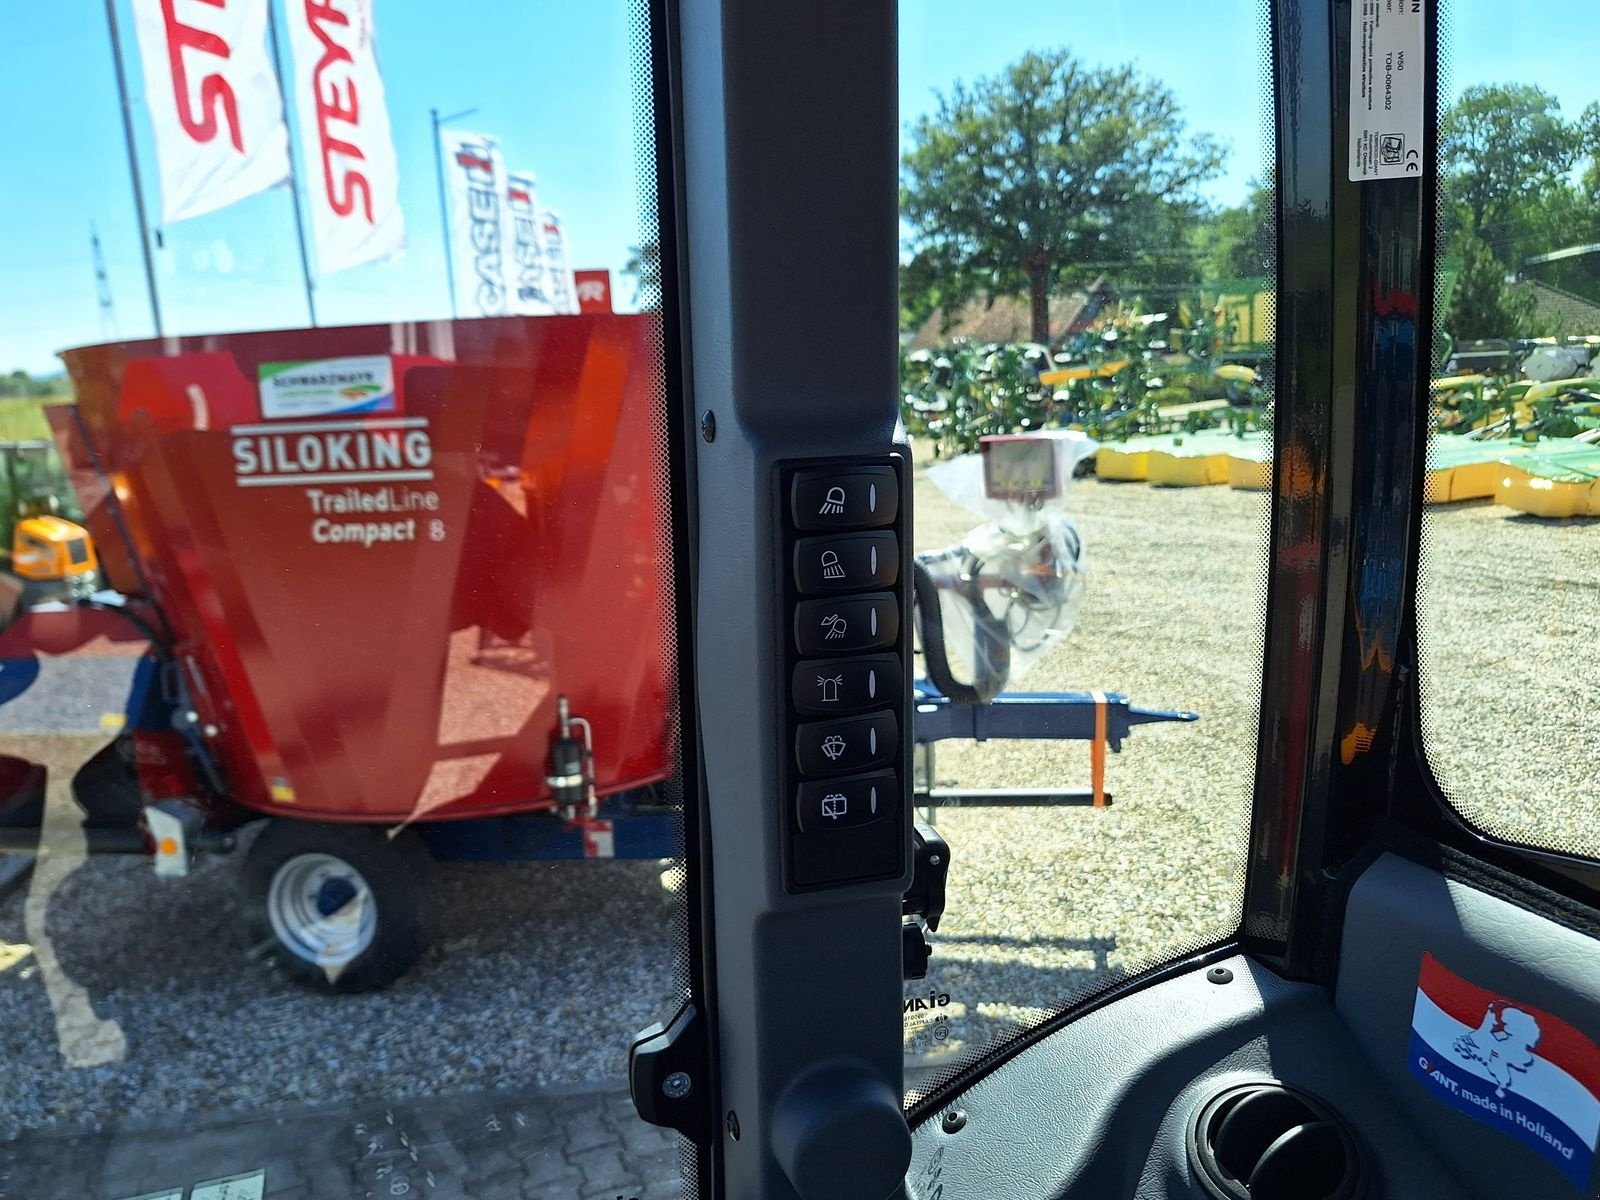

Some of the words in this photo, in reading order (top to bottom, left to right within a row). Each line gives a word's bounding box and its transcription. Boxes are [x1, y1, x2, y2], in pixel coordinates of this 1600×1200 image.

[1384, 52, 1392, 110] TOB-0064302
[232, 430, 433, 475] SILOKING
[305, 487, 440, 514] TrailedLine
[311, 518, 416, 548] Compact
[1461, 1088, 1498, 1113] made
[1500, 1103, 1513, 1120] in
[1516, 1112, 1574, 1160] Holland
